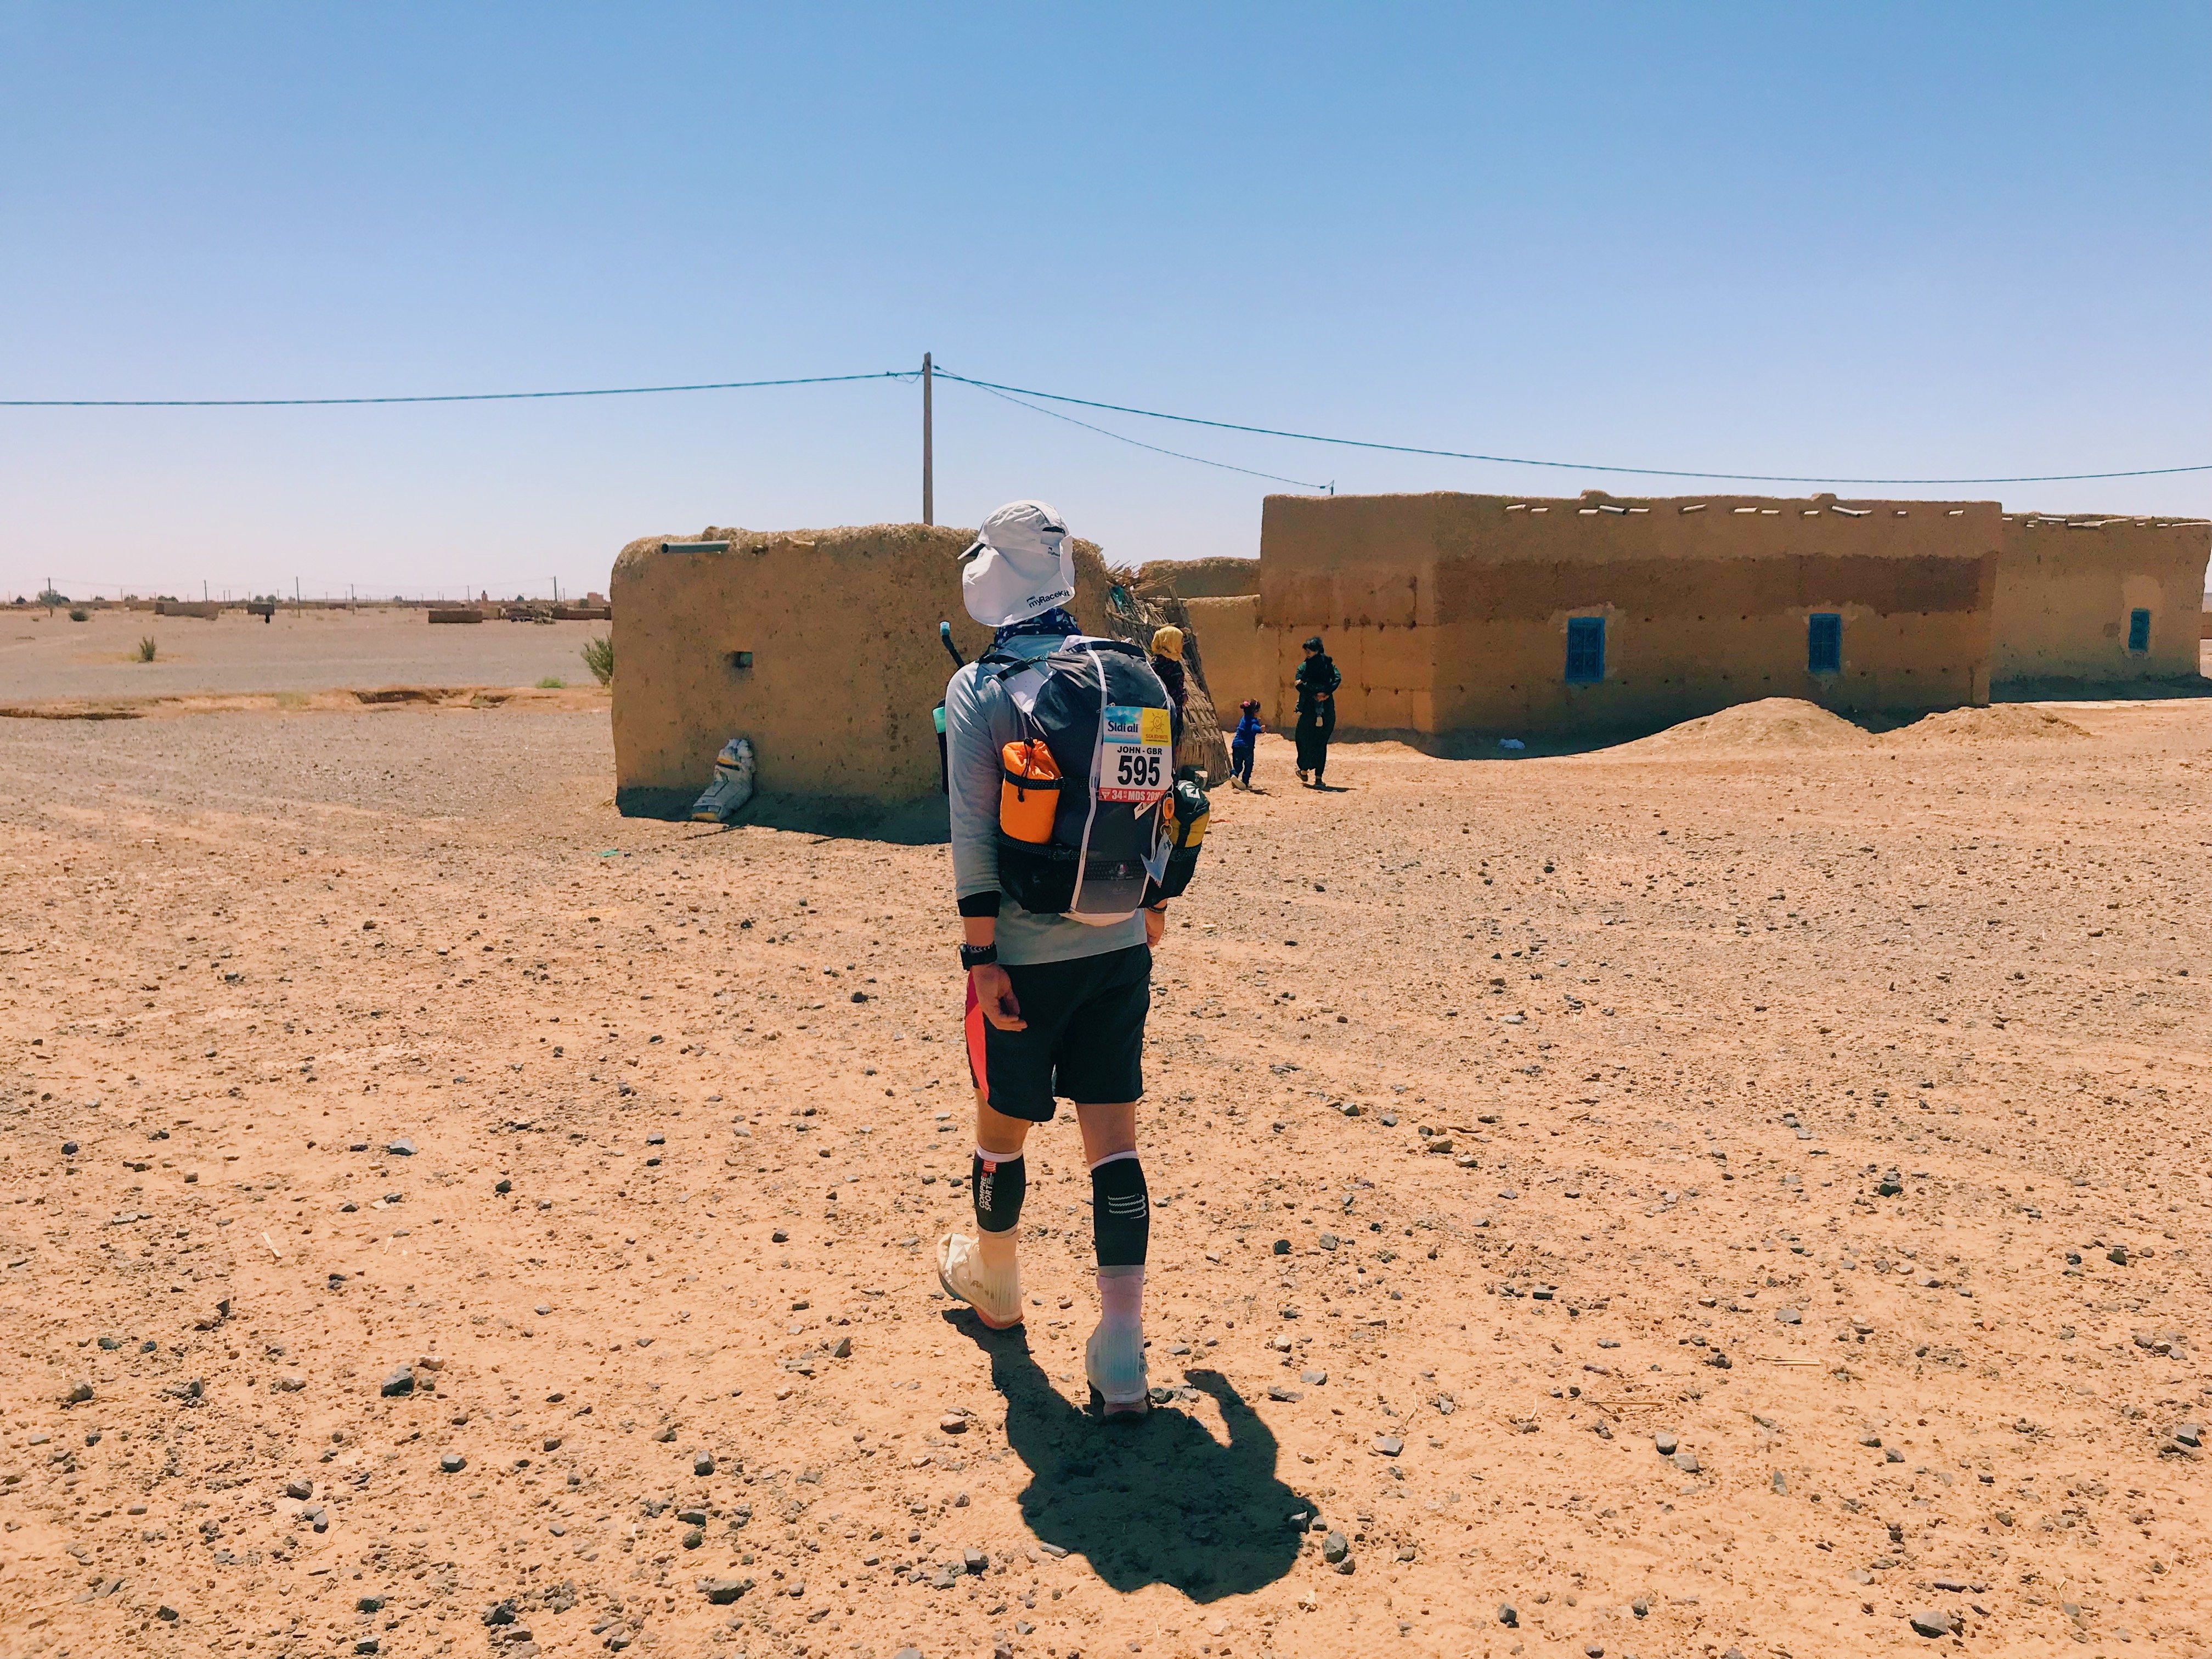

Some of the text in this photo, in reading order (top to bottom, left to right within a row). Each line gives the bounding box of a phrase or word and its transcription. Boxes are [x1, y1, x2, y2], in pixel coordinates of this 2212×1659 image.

[1029, 590, 1070, 608] myRaceKit
[1108, 720, 1138, 733] Sidi ali
[1117, 755, 1160, 787] 595
[1128, 791, 1146, 801] MDS
[984, 1184, 993, 1212] SPORT
